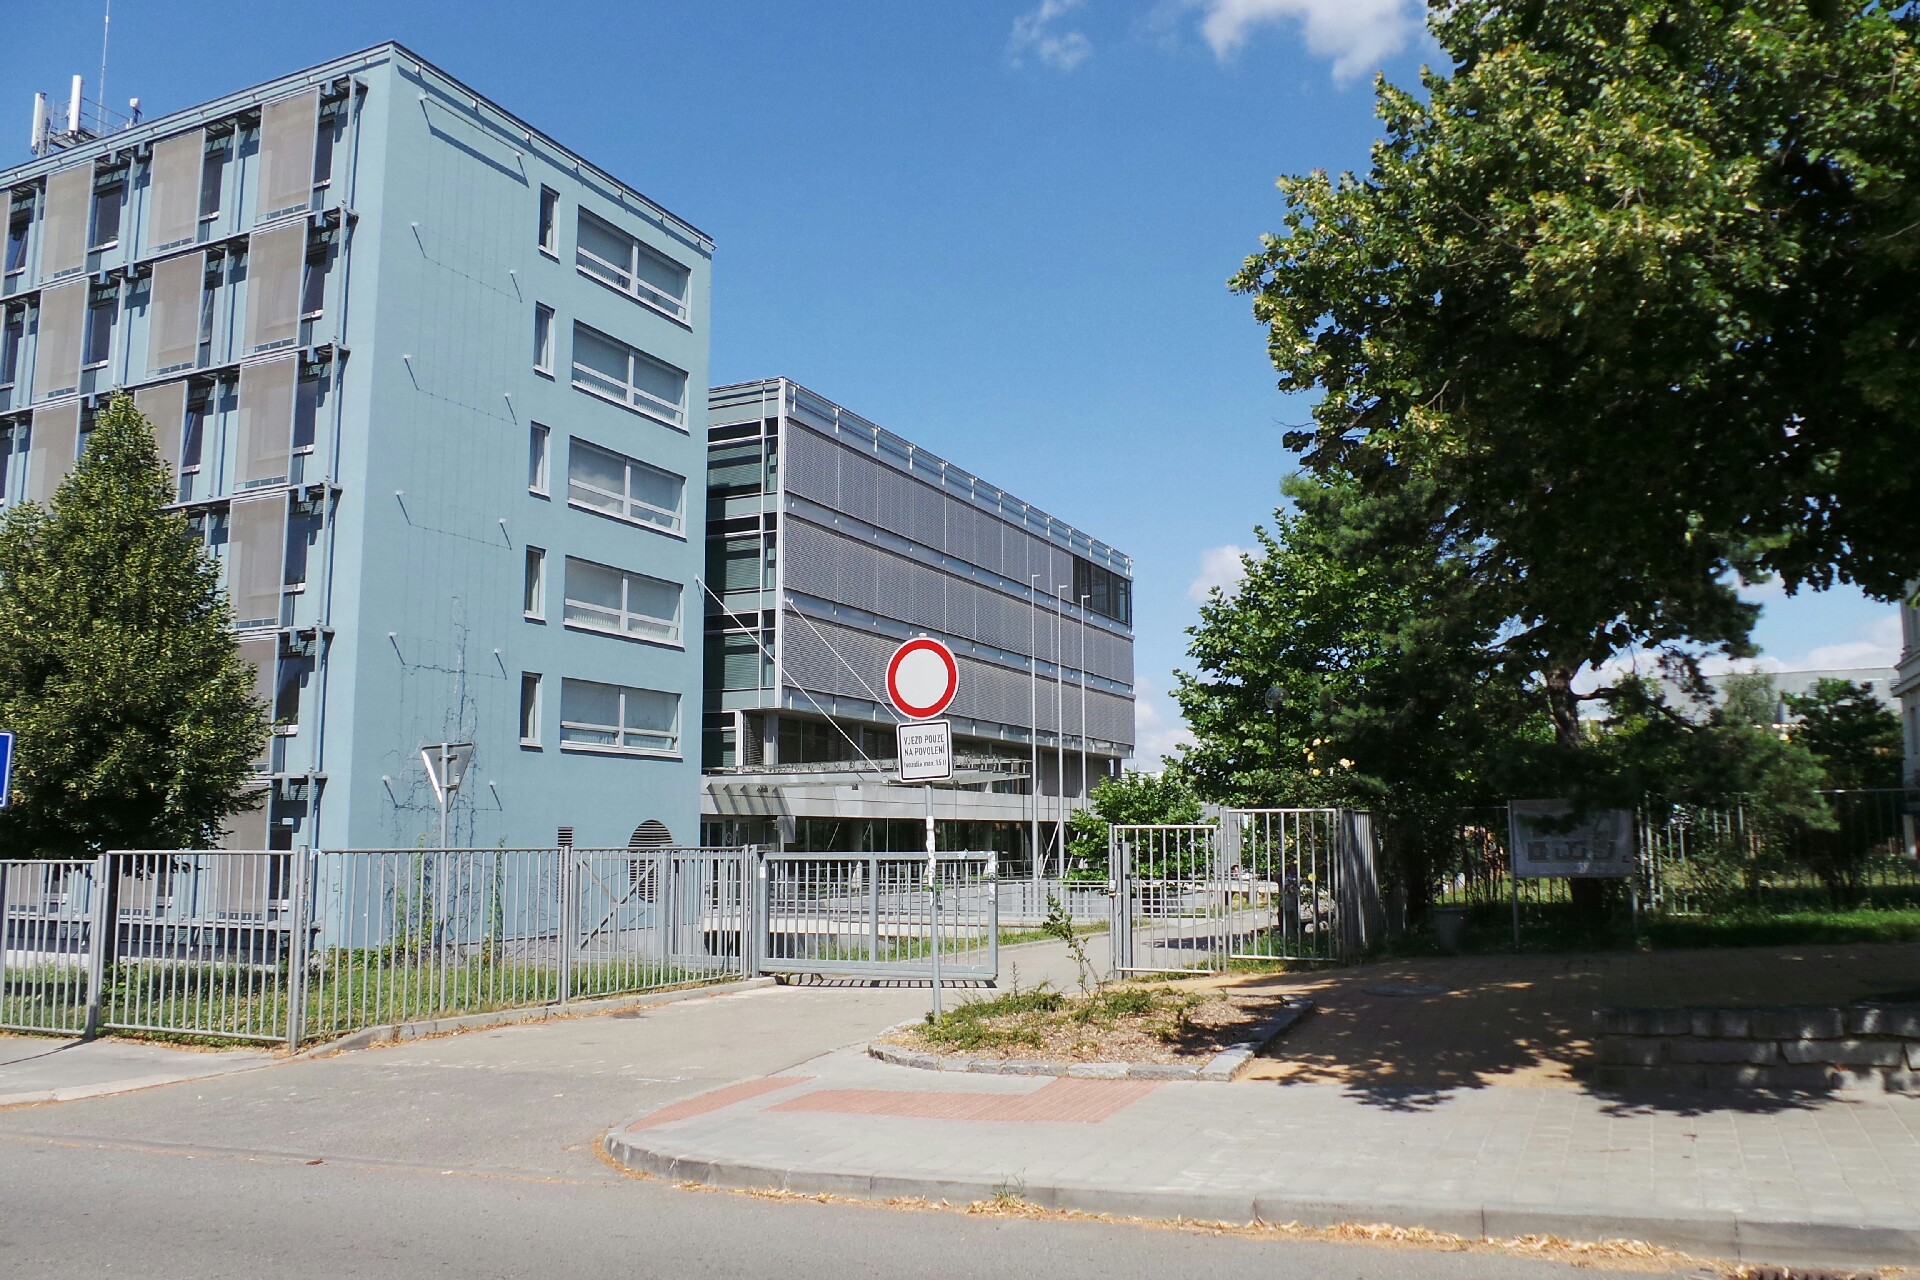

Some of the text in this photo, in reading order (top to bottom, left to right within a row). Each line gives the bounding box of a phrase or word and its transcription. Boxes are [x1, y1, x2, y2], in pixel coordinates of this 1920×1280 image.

[903, 734, 944, 745] VJEZD POUZE
[904, 744, 945, 757] NA POVOLENÍ
